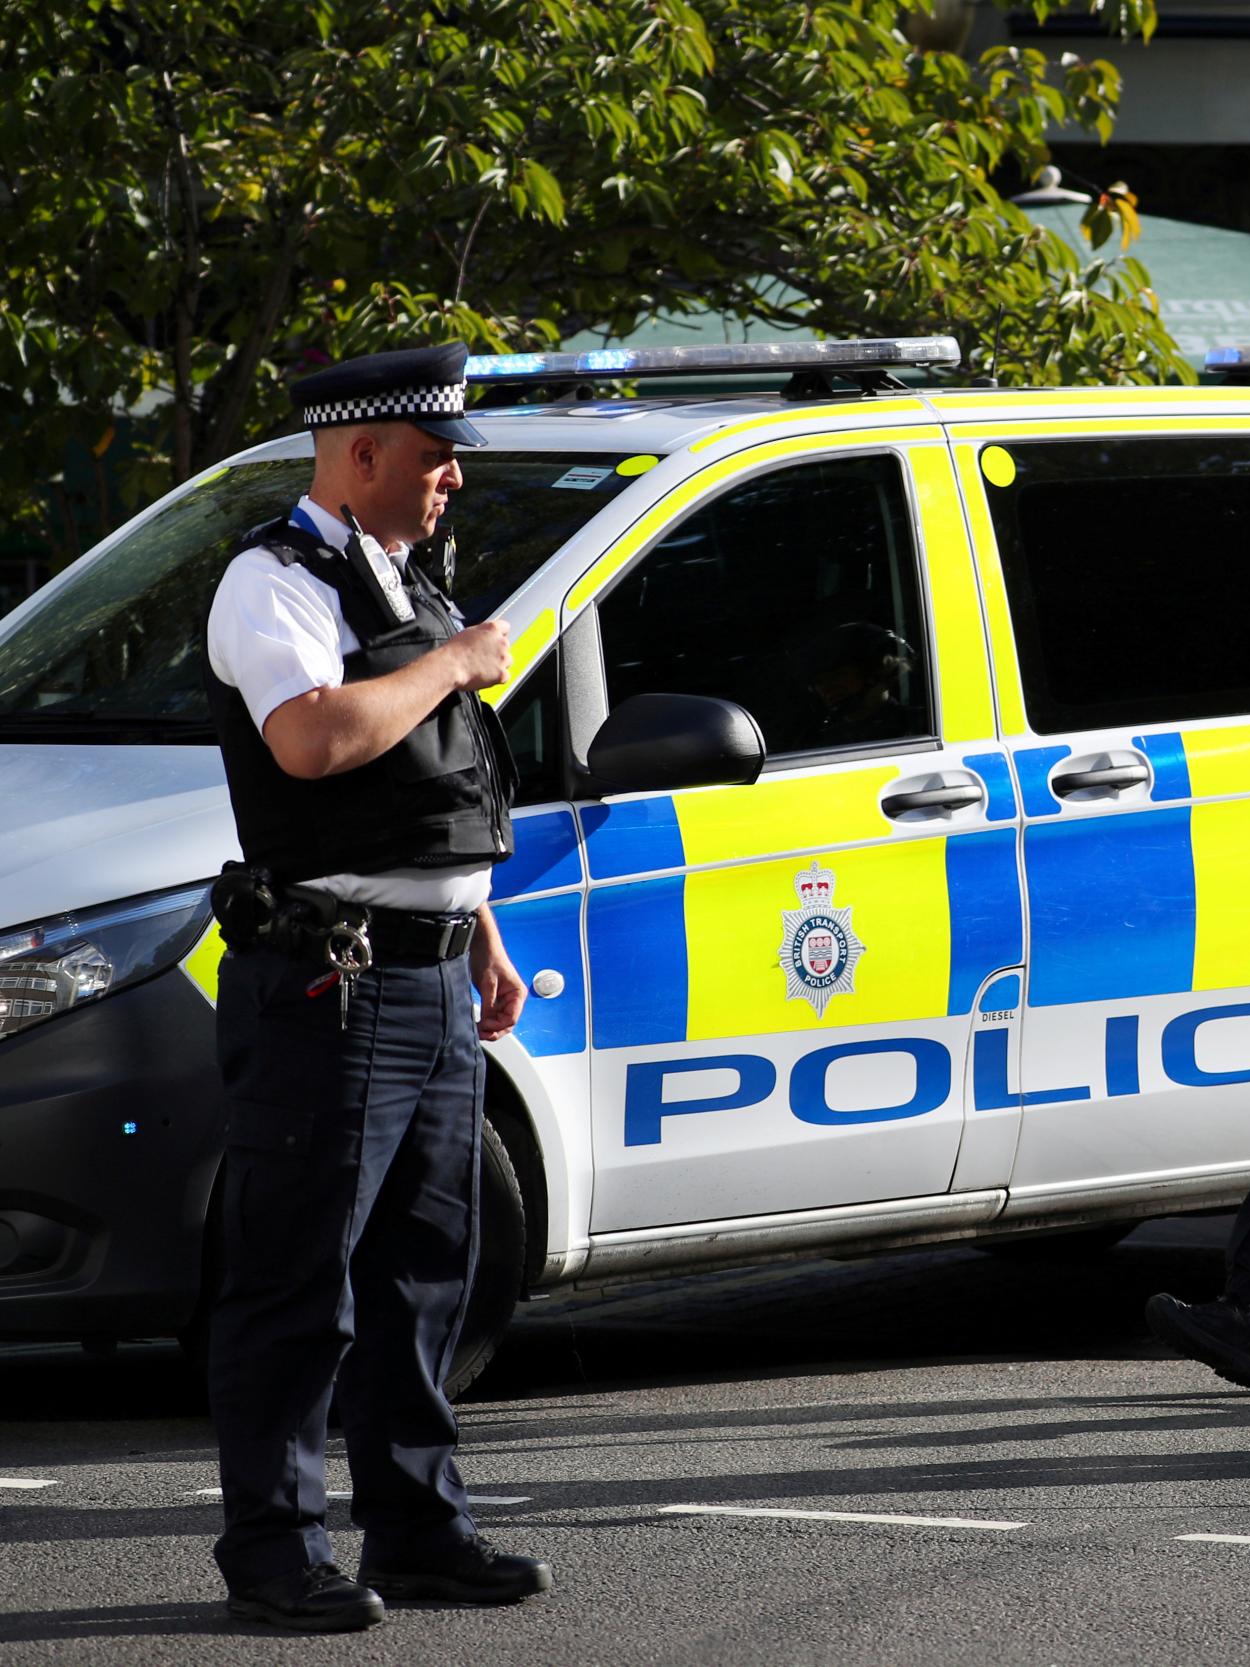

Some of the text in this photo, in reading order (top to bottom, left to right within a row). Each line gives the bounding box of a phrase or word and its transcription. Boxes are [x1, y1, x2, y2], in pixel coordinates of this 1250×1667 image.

[793, 917, 847, 968] BRITISH TRANSPORT
[804, 972, 837, 988] POLICE
[982, 1011, 1014, 1022] DIESEL
